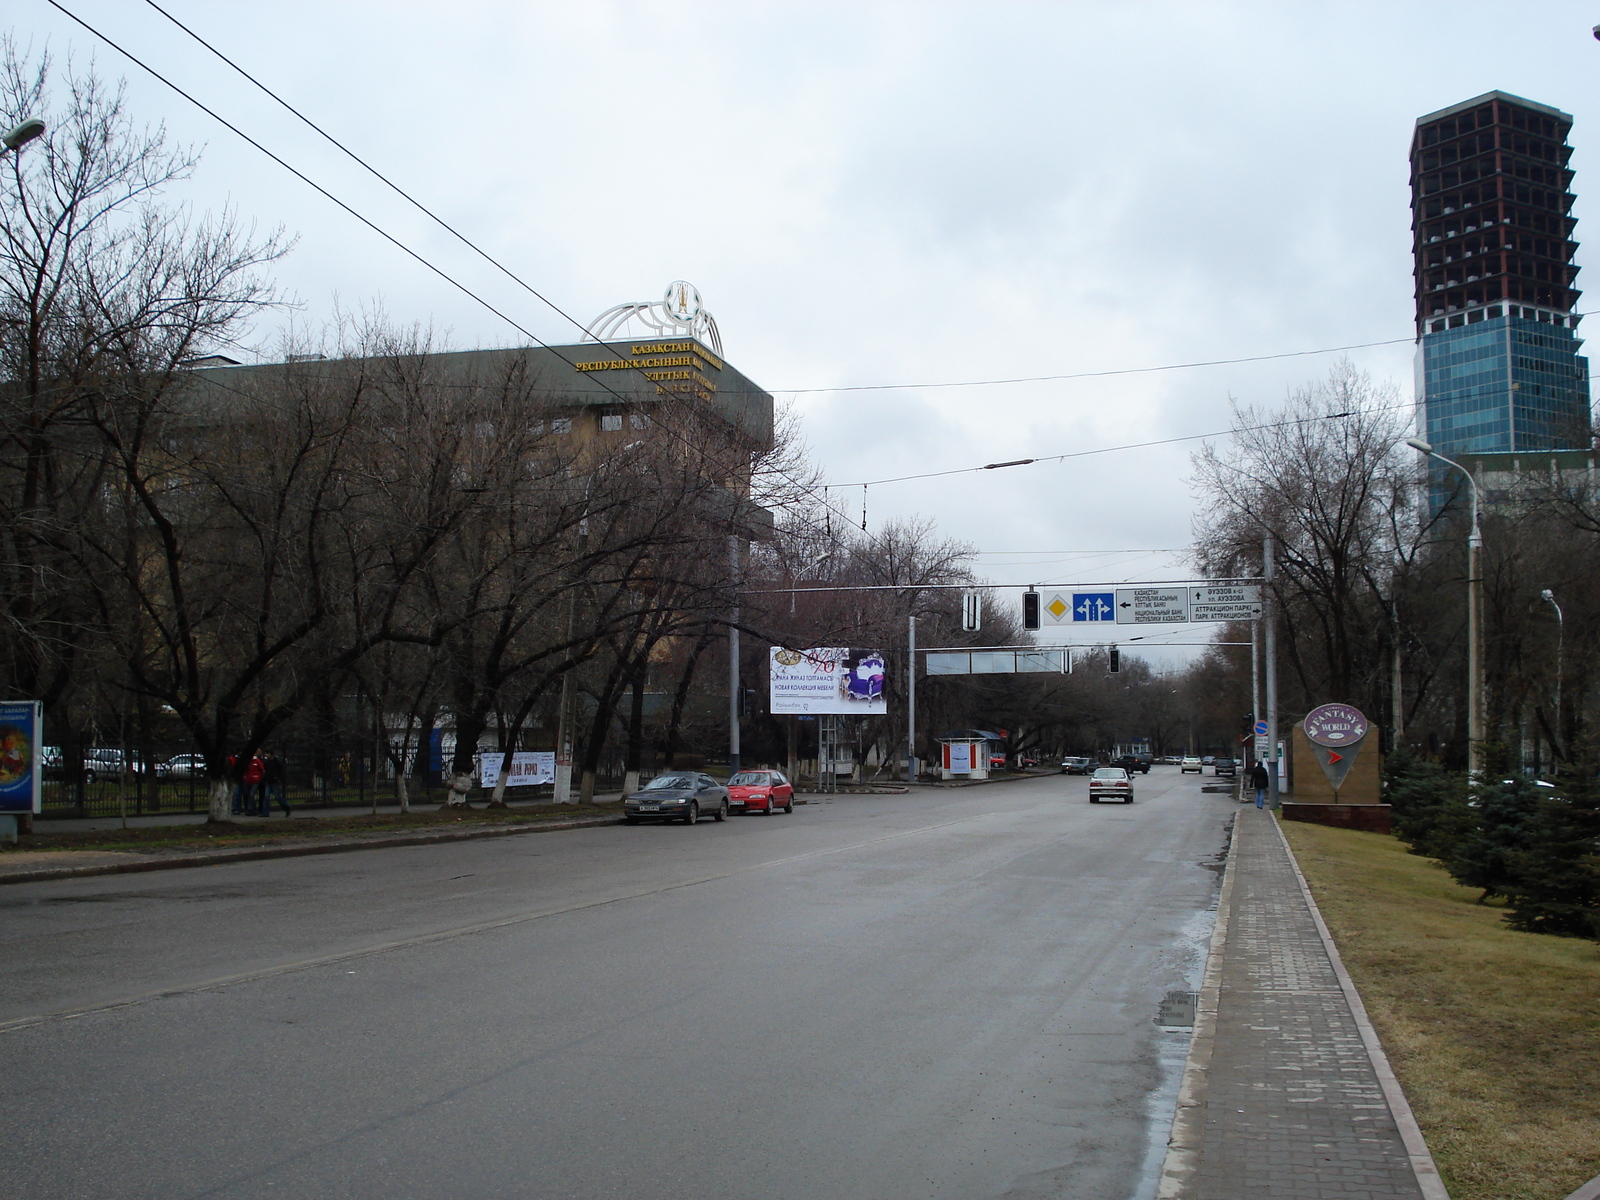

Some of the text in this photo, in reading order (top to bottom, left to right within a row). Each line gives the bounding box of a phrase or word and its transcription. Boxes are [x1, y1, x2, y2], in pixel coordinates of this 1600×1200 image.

[631, 342, 691, 355] ҚАЗАҚСТАН
[1195, 605, 1233, 613] АТТРАКЦИОН
[1312, 710, 1359, 726] FANTASY
[1321, 723, 1351, 732] WORLD
